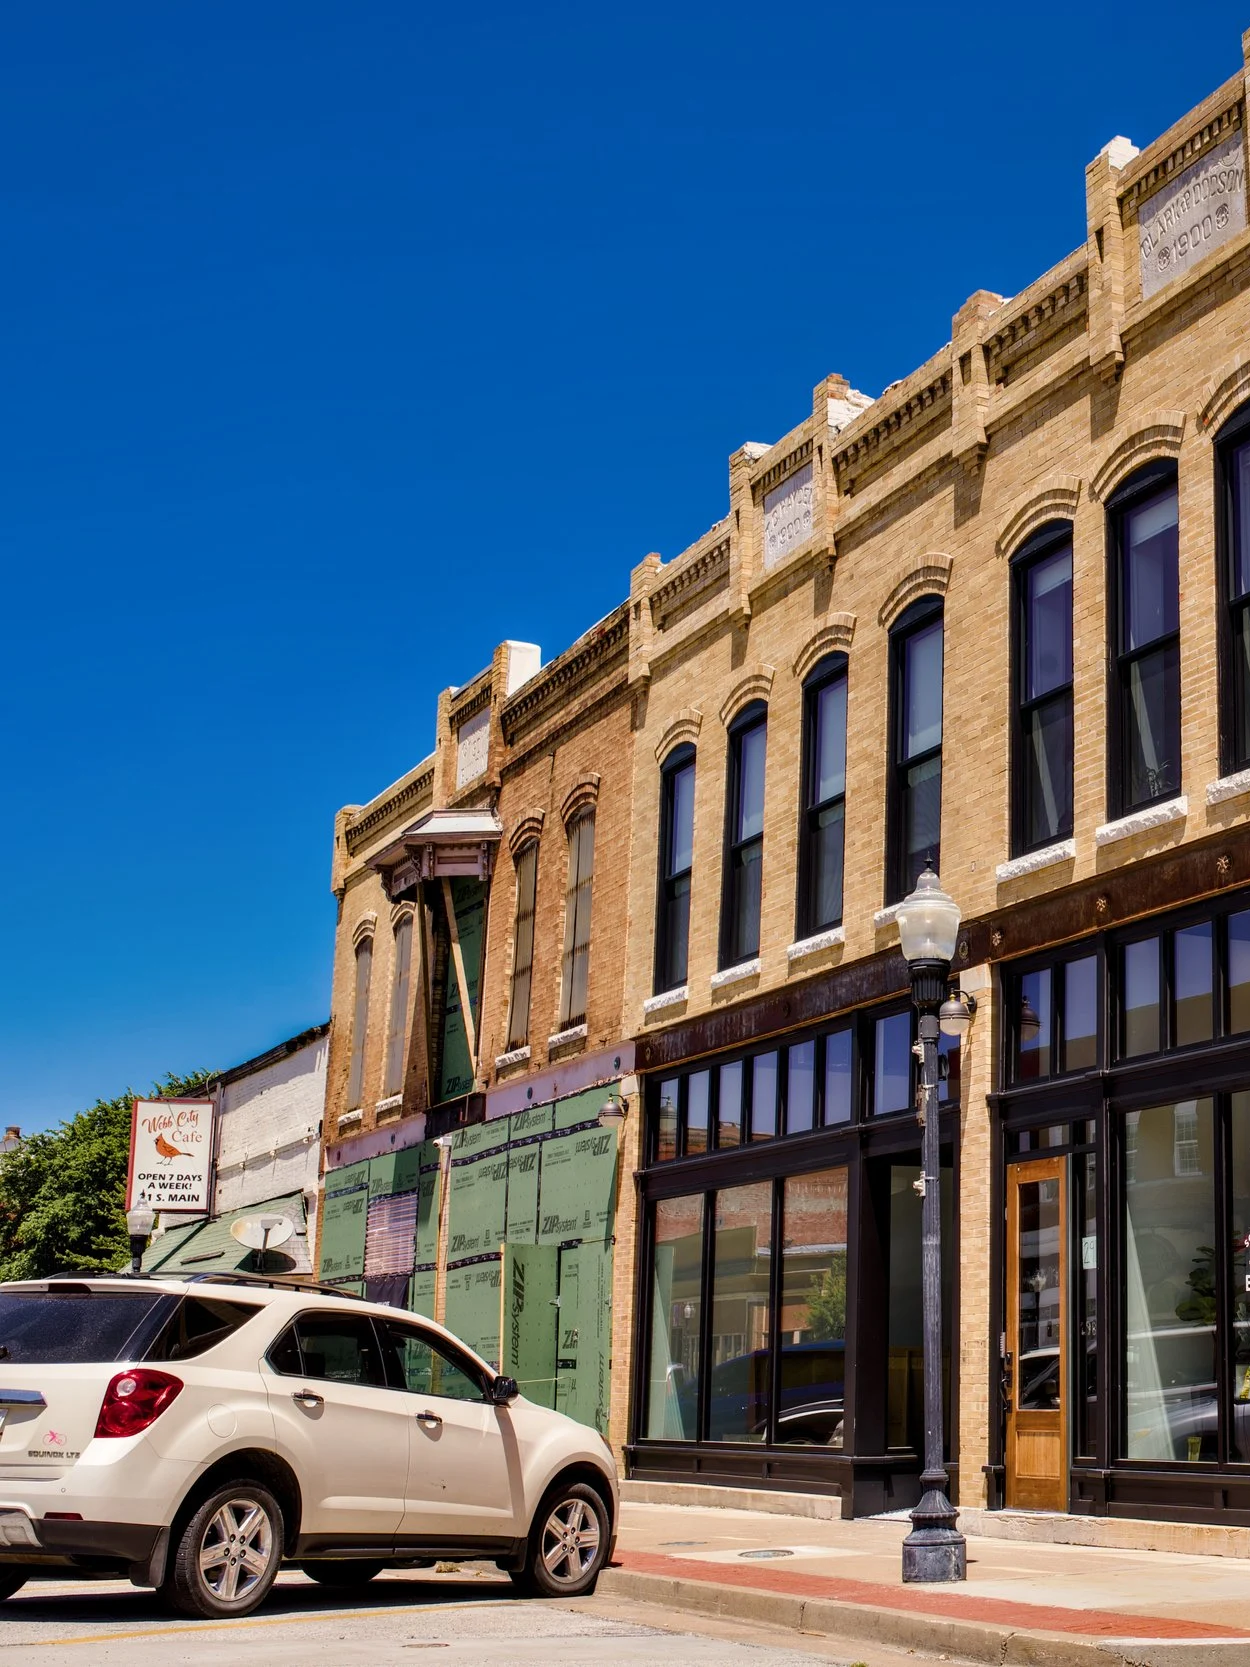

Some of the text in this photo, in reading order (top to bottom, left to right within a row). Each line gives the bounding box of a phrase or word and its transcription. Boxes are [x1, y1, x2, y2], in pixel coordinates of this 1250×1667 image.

[1140, 197, 1180, 259] CLARK
[1192, 169, 1244, 207] DODSON
[1172, 214, 1213, 263] 1900
[142, 1110, 199, 1133] Webb City
[172, 1130, 203, 1143] Cafe
[138, 1173, 166, 1181] OPEN
[176, 1174, 202, 1182] DAYS
[148, 1182, 192, 1190] A WEEK!
[156, 1193, 165, 1202] S.
[168, 1194, 200, 1202] MAIN
[28, 1450, 81, 1459] EQUINOX LTZ
